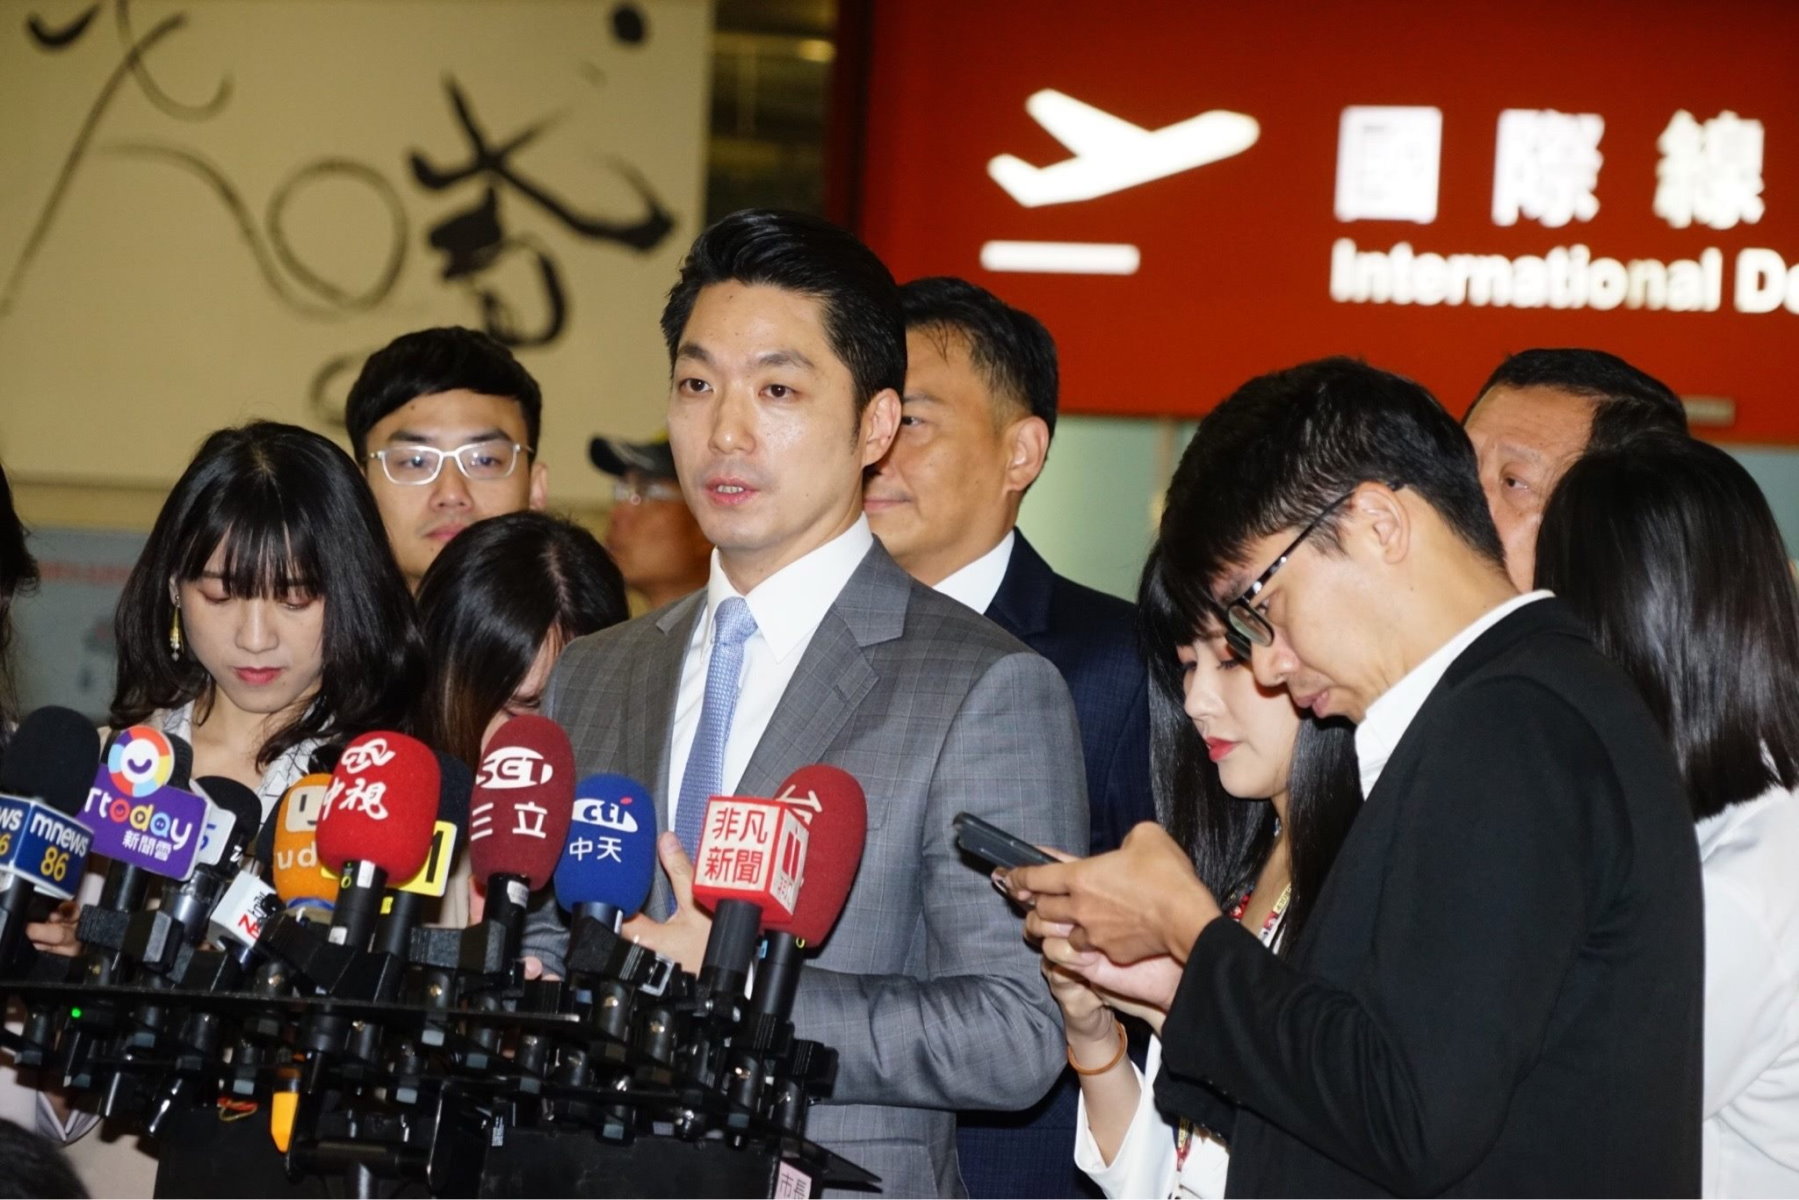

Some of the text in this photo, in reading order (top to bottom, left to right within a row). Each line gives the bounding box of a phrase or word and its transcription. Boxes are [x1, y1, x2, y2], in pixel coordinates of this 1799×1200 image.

[1330, 237, 1724, 312] International
[30, 812, 89, 858] mnews
[470, 801, 548, 842] 三立
[712, 807, 768, 844] 非凡
[41, 846, 70, 882] 86
[569, 836, 622, 863] 中天
[704, 846, 763, 885] 新聞
